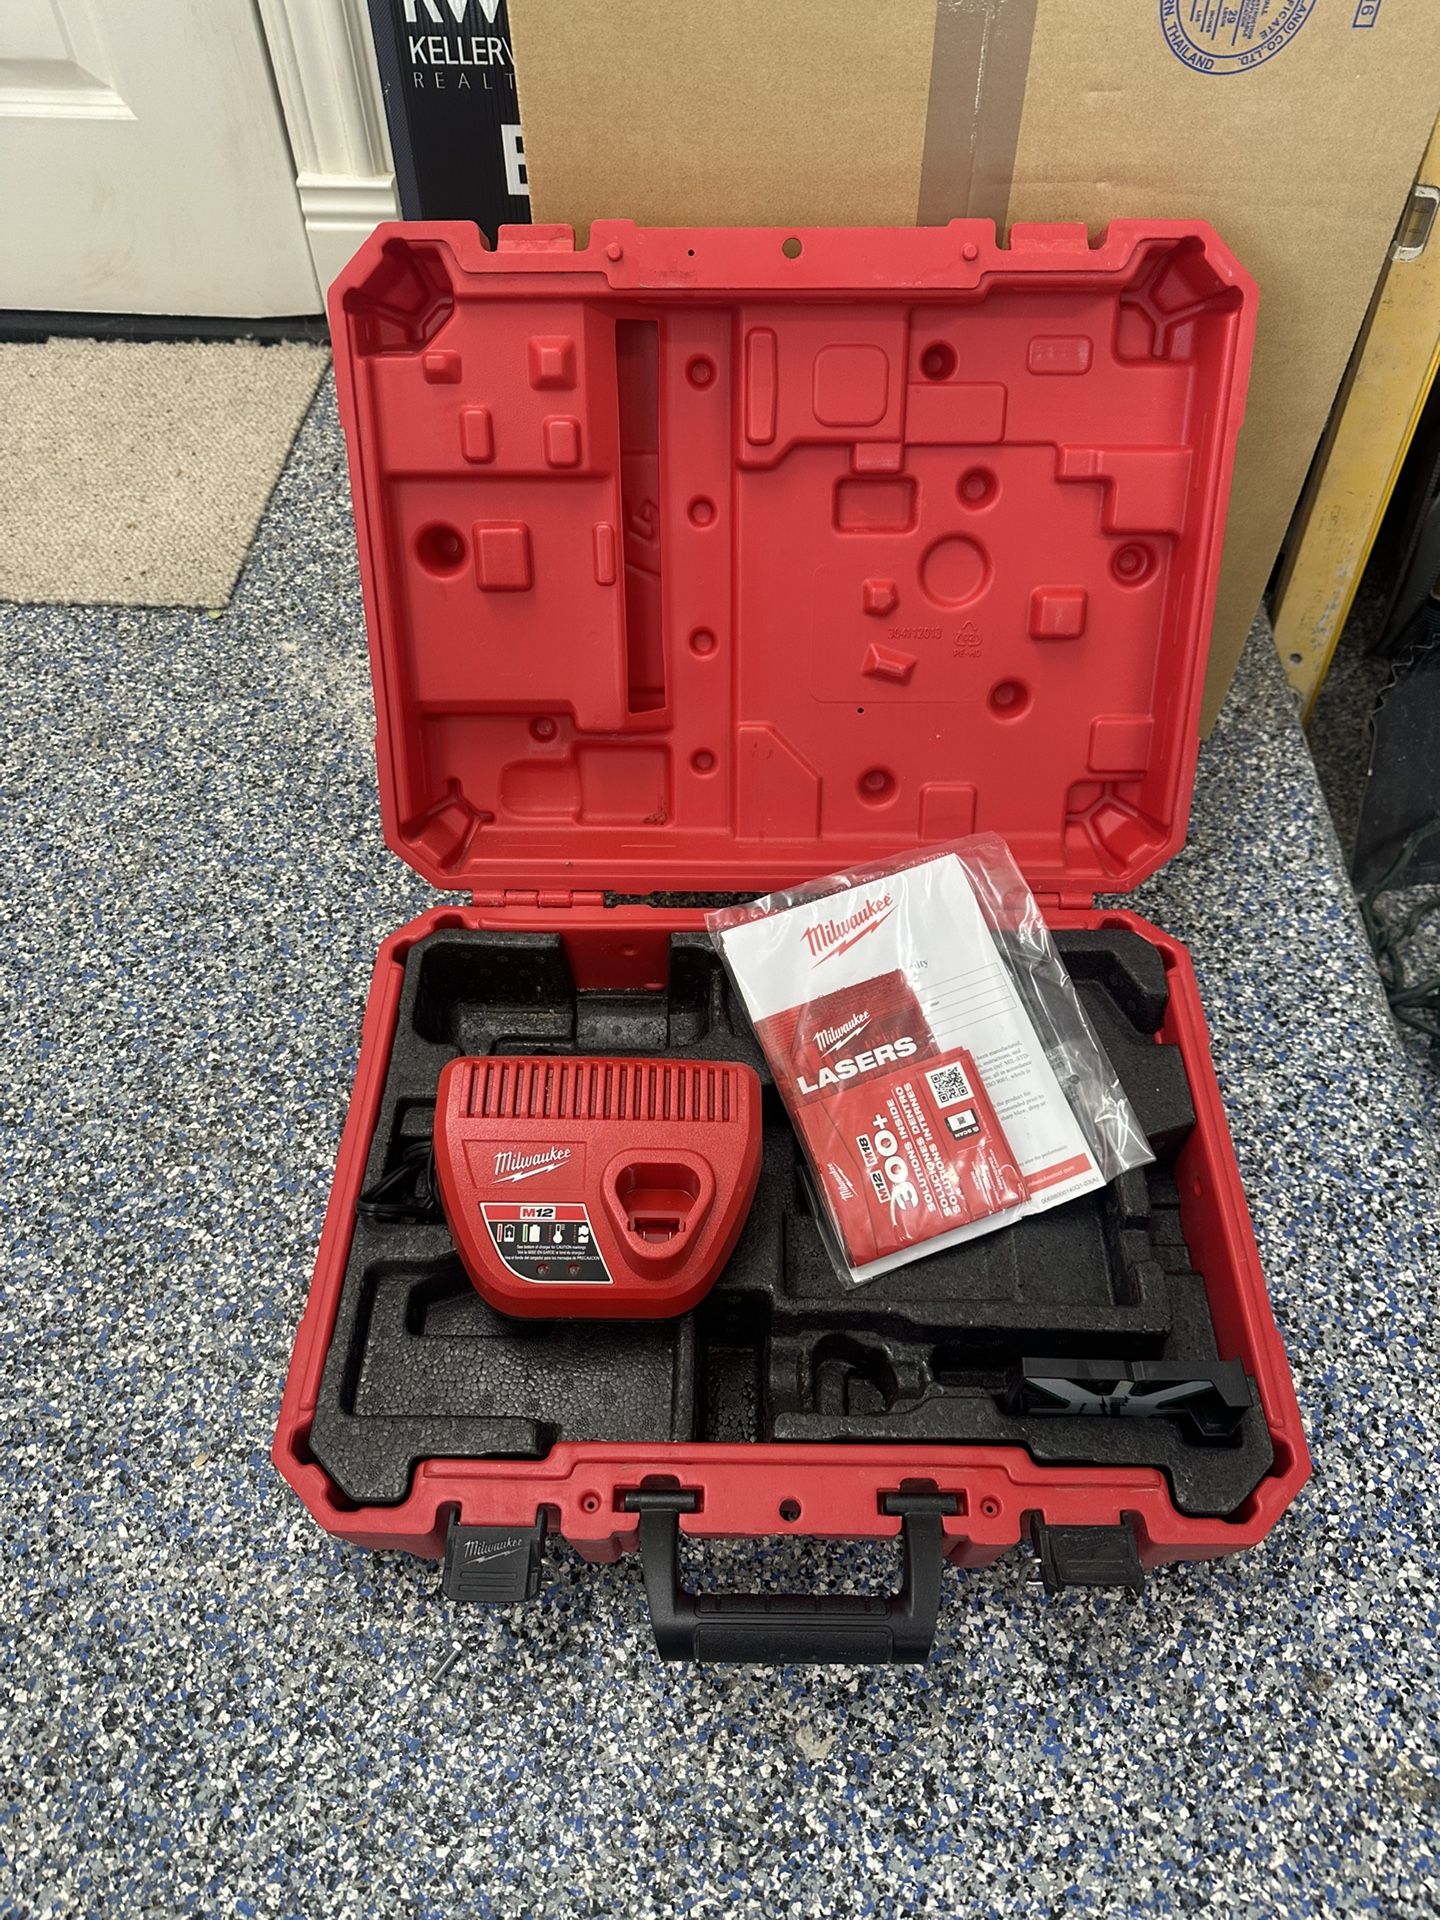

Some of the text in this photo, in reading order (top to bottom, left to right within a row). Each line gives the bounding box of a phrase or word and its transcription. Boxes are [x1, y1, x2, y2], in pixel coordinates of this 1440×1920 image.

[1227, 10, 1238, 24] 29
[1283, 0, 1307, 35] AND)
[1167, 21, 1215, 70] THAILAND
[801, 894, 893, 958] Milwaukee
[813, 1010, 870, 1052] Milwaukee
[797, 1036, 918, 1095] LASERS
[493, 1146, 572, 1176] Milwaukee
[858, 1136, 890, 1201] M12 M18
[872, 1113, 919, 1211] 300+
[886, 1098, 936, 1212] SOLUTIONS INSIDE
[895, 1086, 952, 1217] SOLUCIONES DENTRO
[903, 1082, 961, 1214] SOLUTIONS INTERNES
[522, 1208, 554, 1218] M12
[463, 1536, 524, 1558] Milwaukee
